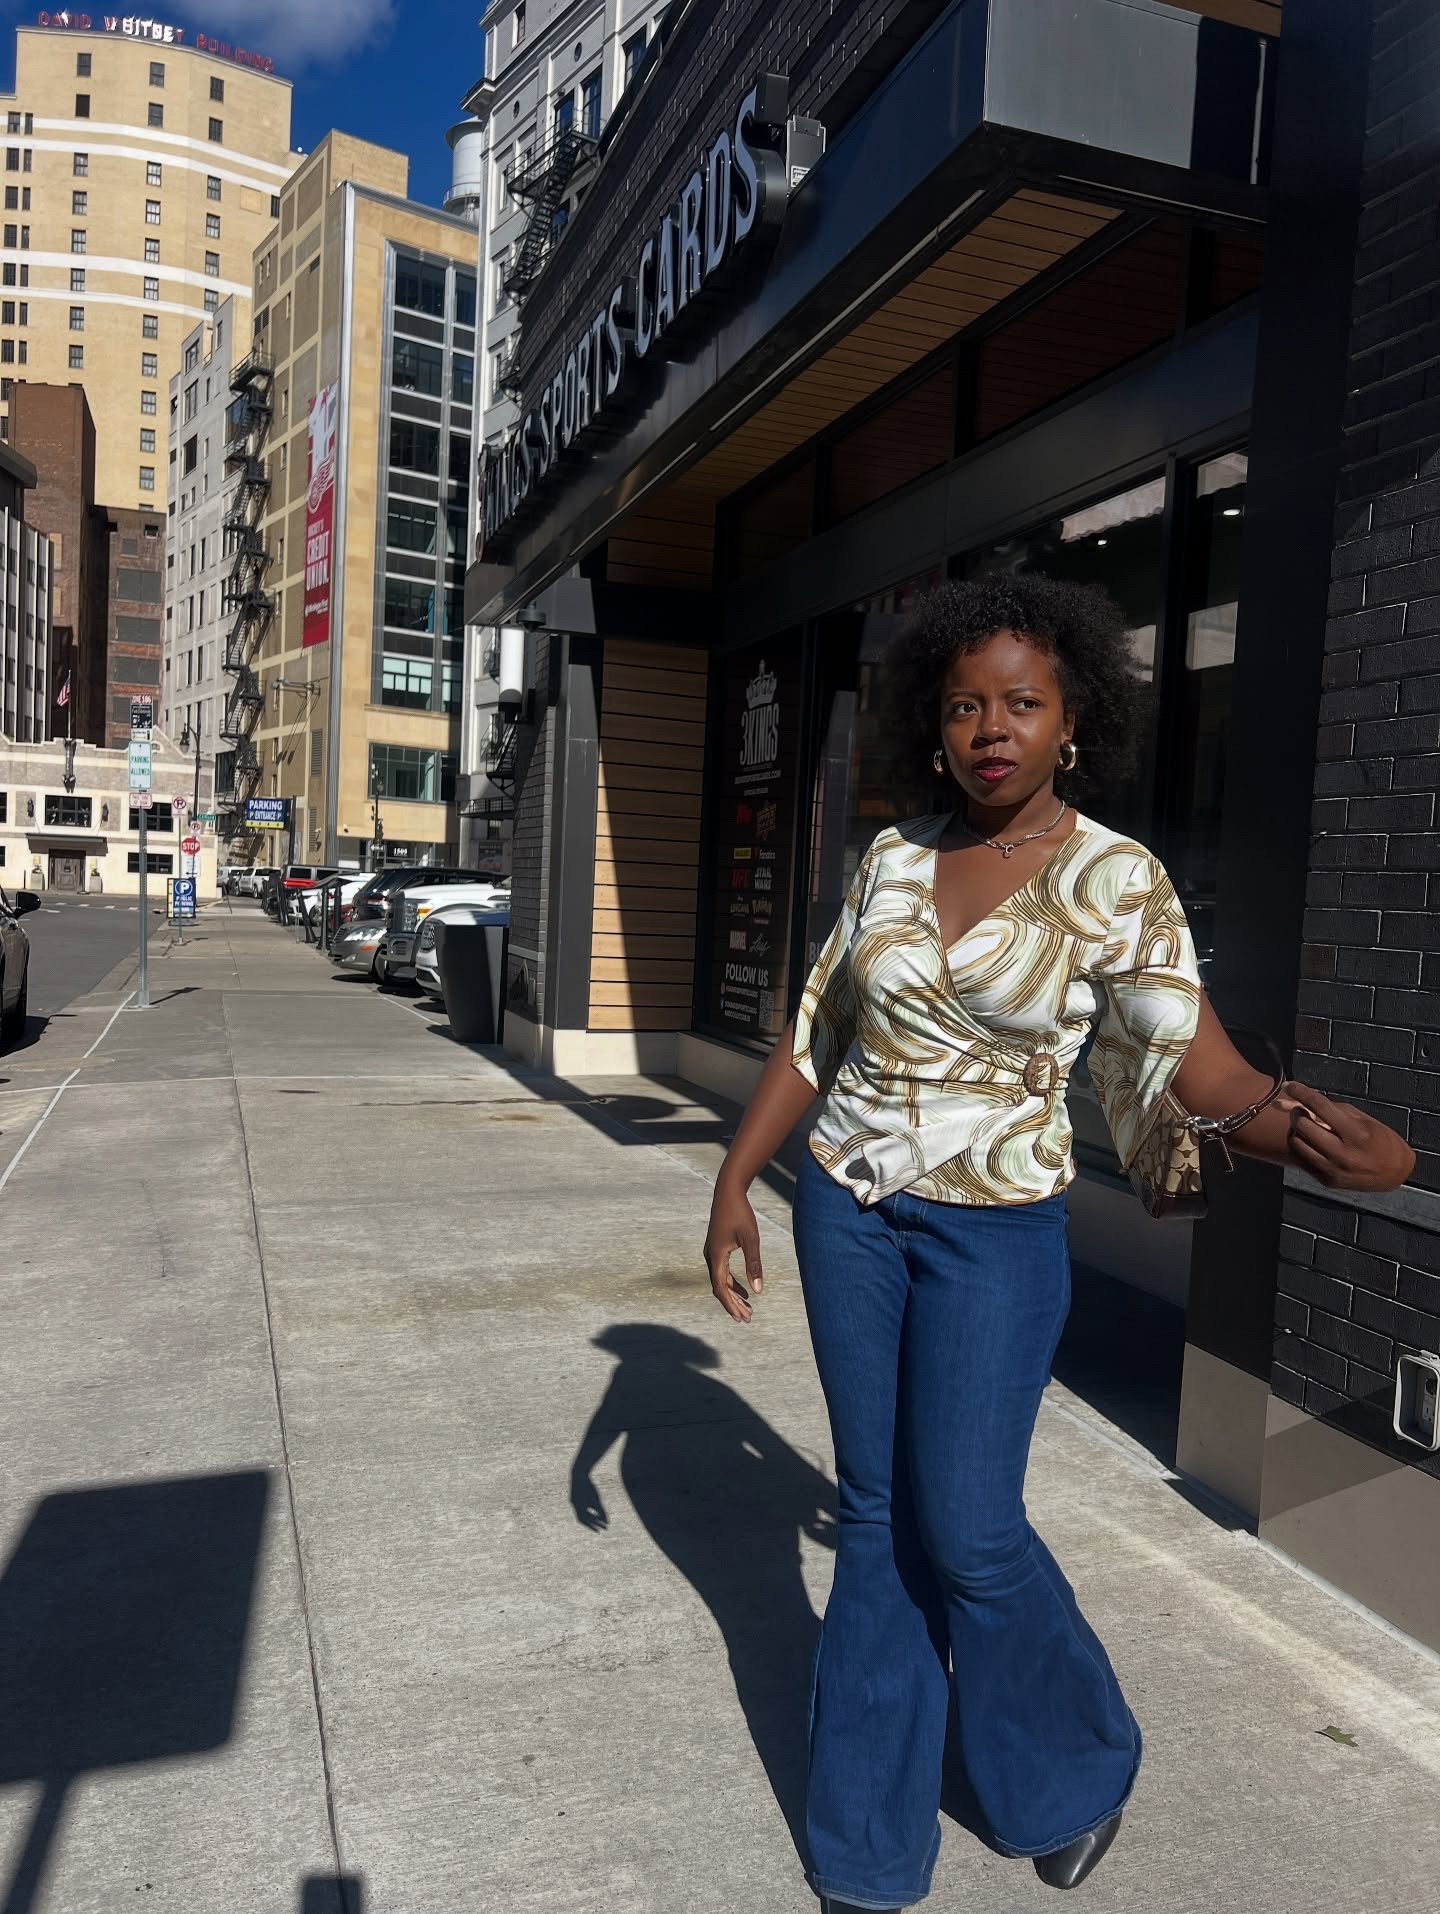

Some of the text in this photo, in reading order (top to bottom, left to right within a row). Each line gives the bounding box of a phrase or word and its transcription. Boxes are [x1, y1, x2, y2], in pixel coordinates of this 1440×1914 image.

[196, 33, 274, 73] BUILDING
[538, 285, 623, 478] SPORTS
[636, 86, 758, 358] CARDS
[307, 530, 330, 566] CREDIT
[739, 703, 780, 765] 3KINGS
[131, 755, 149, 764] PARKING
[130, 767, 150, 776] ALLOWED
[249, 800, 283, 811] PARKING
[255, 811, 276, 820] ENTRANCE
[182, 841, 200, 853] STOP
[754, 867, 773, 878] STAR
[754, 879, 772, 890] WARS
[729, 930, 747, 950] MARVEL
[725, 962, 769, 987] FOLLOW US
